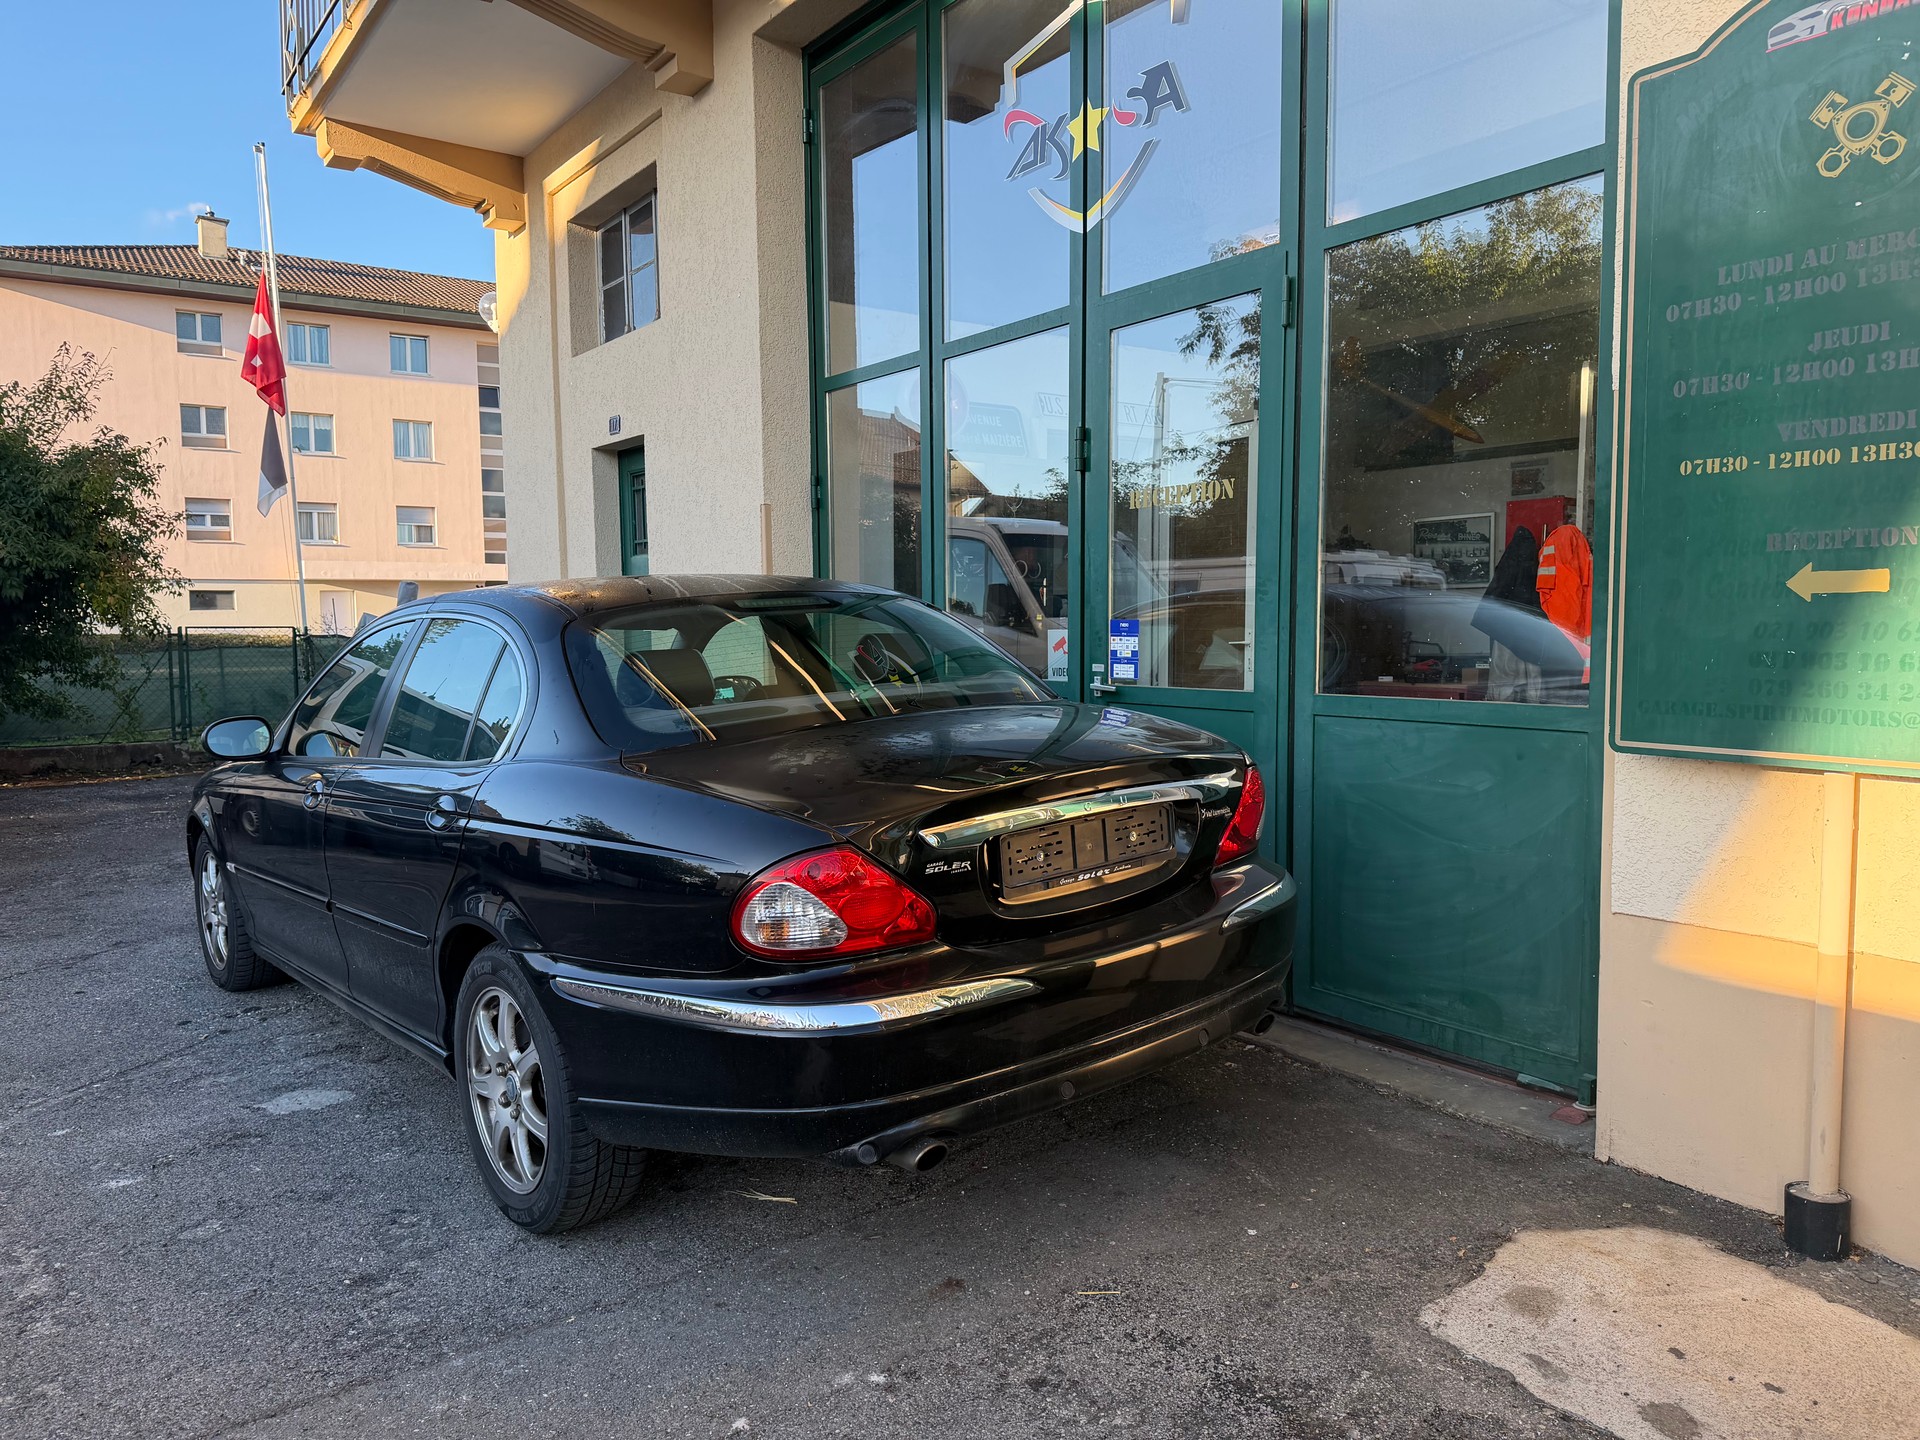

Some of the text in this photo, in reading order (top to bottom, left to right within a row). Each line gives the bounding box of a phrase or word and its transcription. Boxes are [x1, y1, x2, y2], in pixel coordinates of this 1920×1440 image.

[1718, 252, 1794, 286] LUNDI
[1800, 244, 1838, 270] AU
[1666, 292, 1742, 322] 07H30
[1764, 271, 1847, 305] 12H00
[1808, 321, 1892, 352] JEUDI
[1673, 371, 1749, 399] 07H30
[1773, 357, 1855, 386] 12H00
[1777, 409, 1917, 442] VENDREDI
[1679, 455, 1748, 476] 07H30
[1768, 448, 1841, 470] 12H00
[1857, 682, 1890, 701] 34
[925, 861, 971, 875] SOLER
